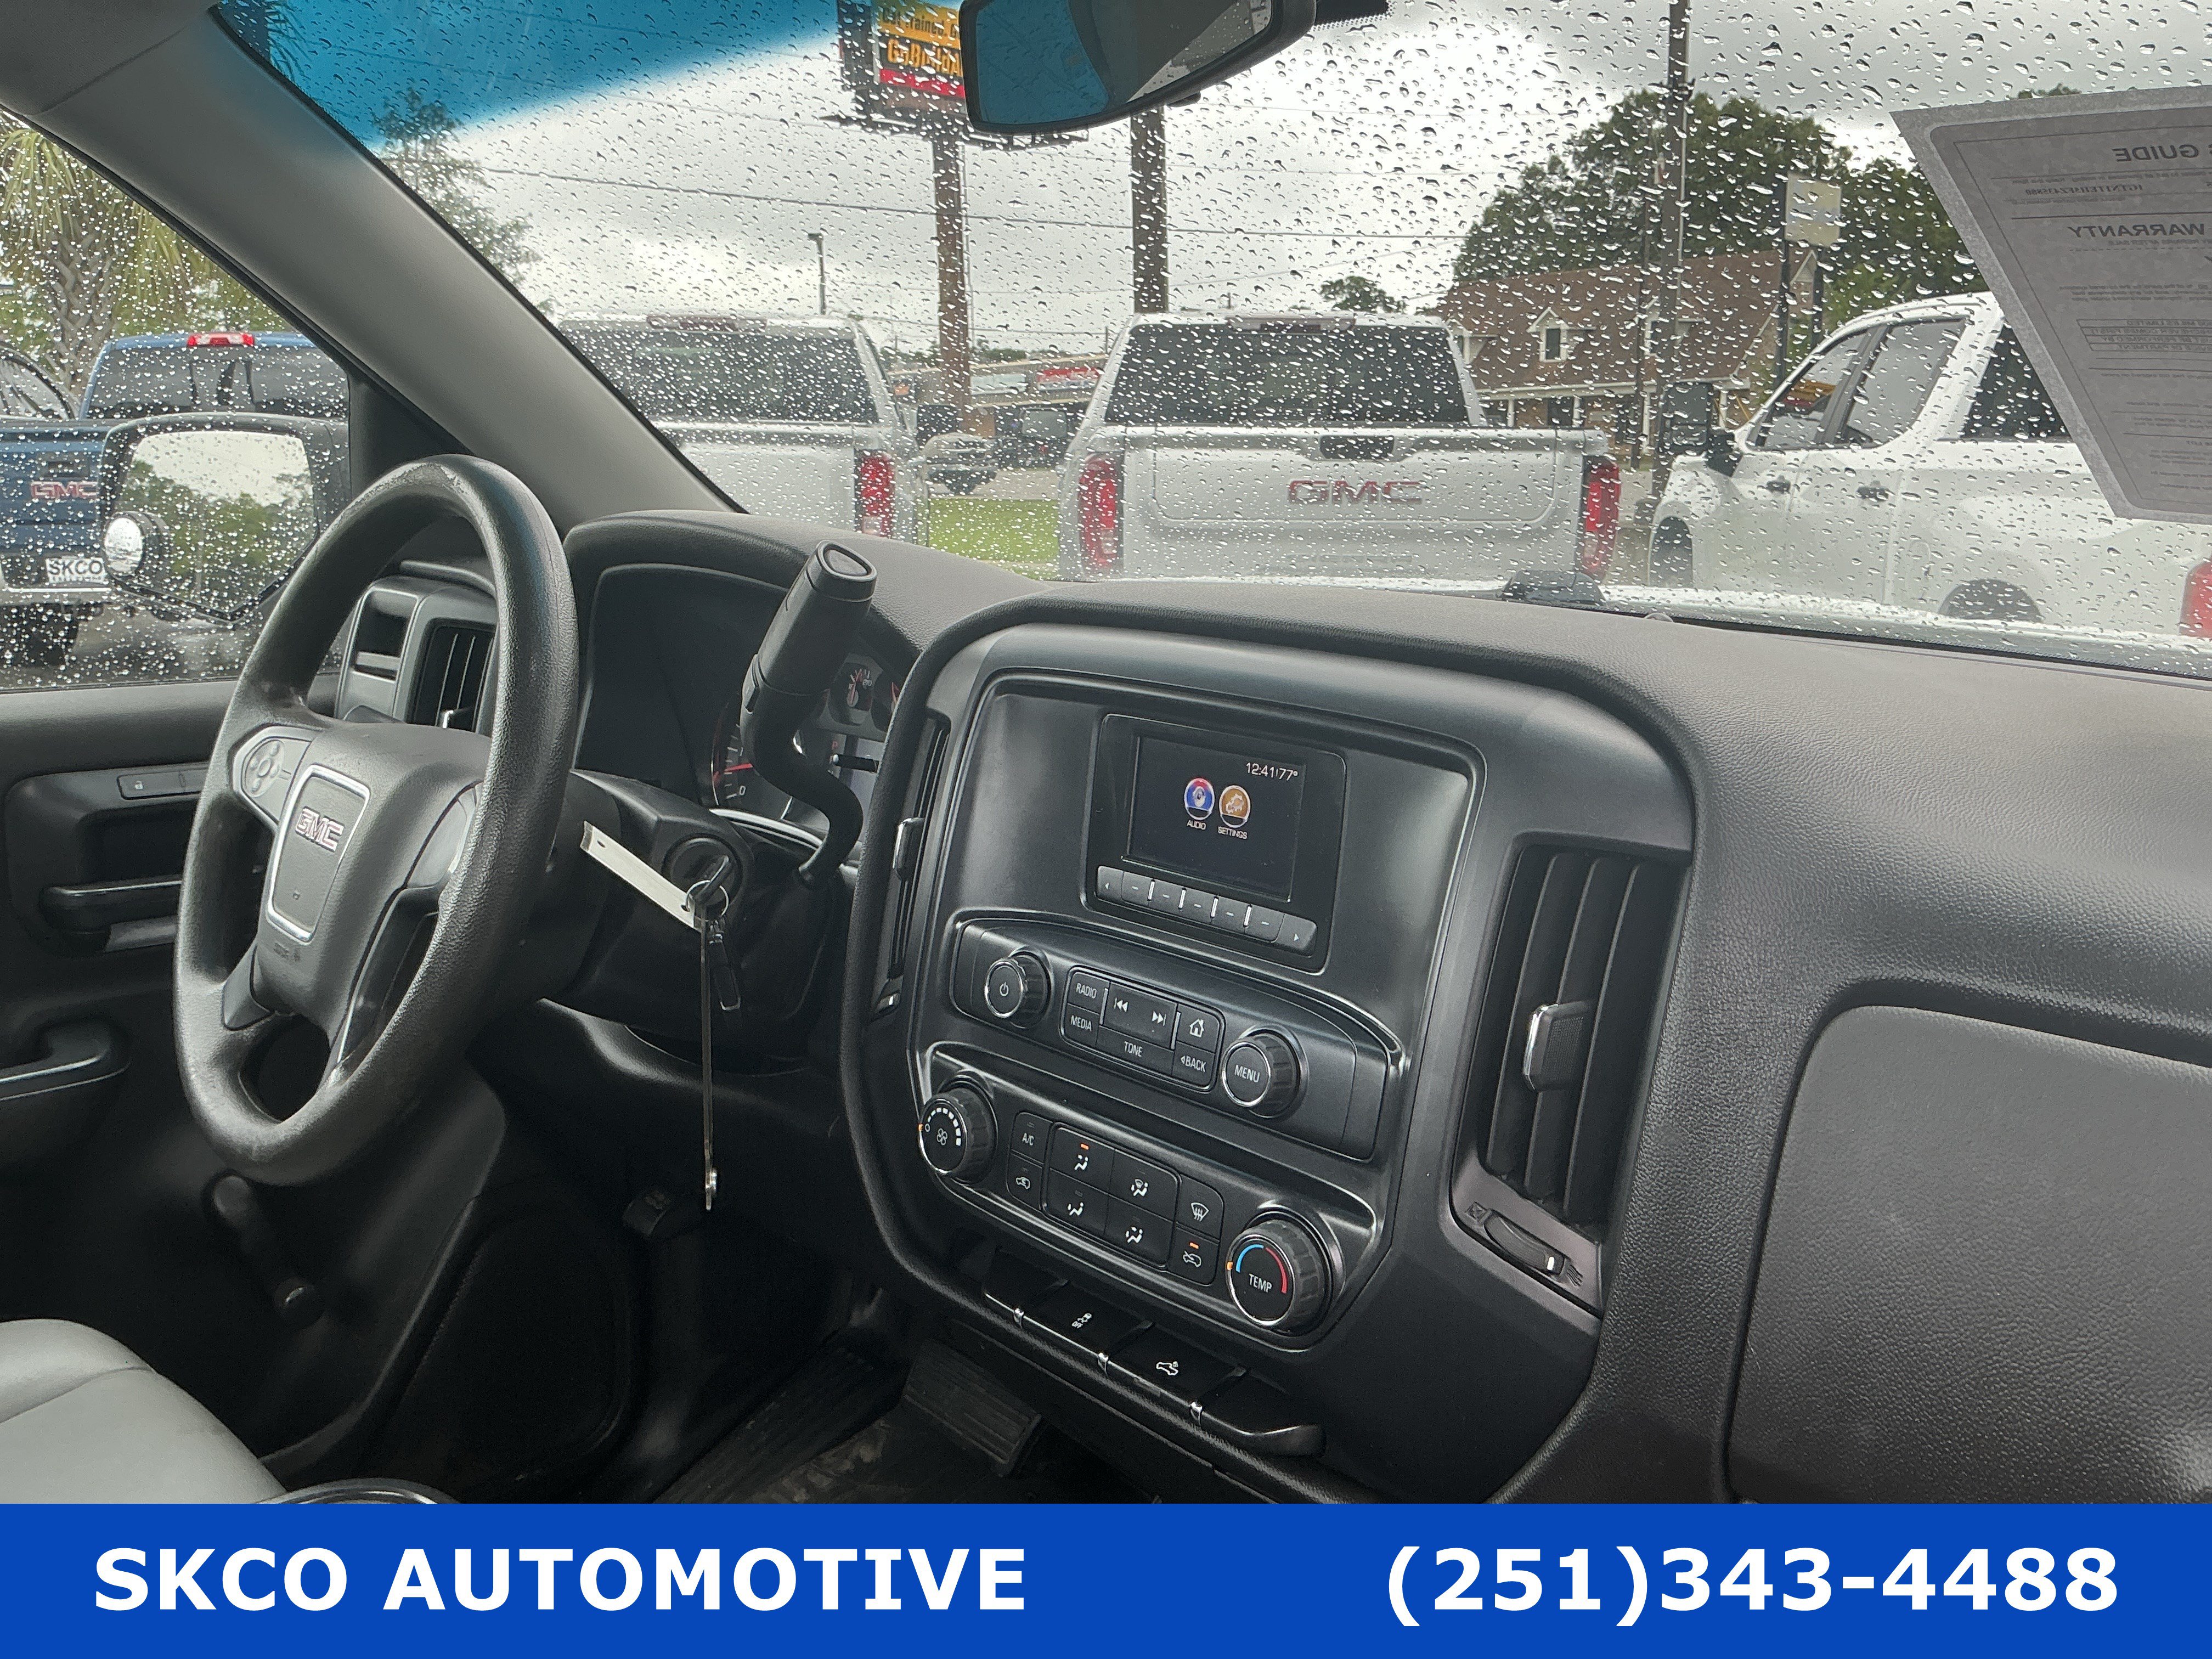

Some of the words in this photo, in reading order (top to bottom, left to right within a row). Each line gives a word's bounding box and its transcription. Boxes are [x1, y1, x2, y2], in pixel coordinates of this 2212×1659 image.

[30, 481, 100, 500] GMC
[1289, 479, 1423, 504] GMC
[49, 560, 103, 575] SKCO
[295, 806, 345, 852] GMC
[1187, 820, 1207, 831] AUDIO
[1217, 826, 1248, 840] SETTINGS
[1076, 983, 1097, 1000] RADIO
[1070, 1015, 1092, 1032] MEDIA
[1124, 1041, 1143, 1058] TONE
[1185, 1056, 1206, 1073] BACK
[1234, 1064, 1261, 1084] MENU
[1022, 1132, 1035, 1146] A/C
[1249, 1273, 1272, 1293] TEMP
